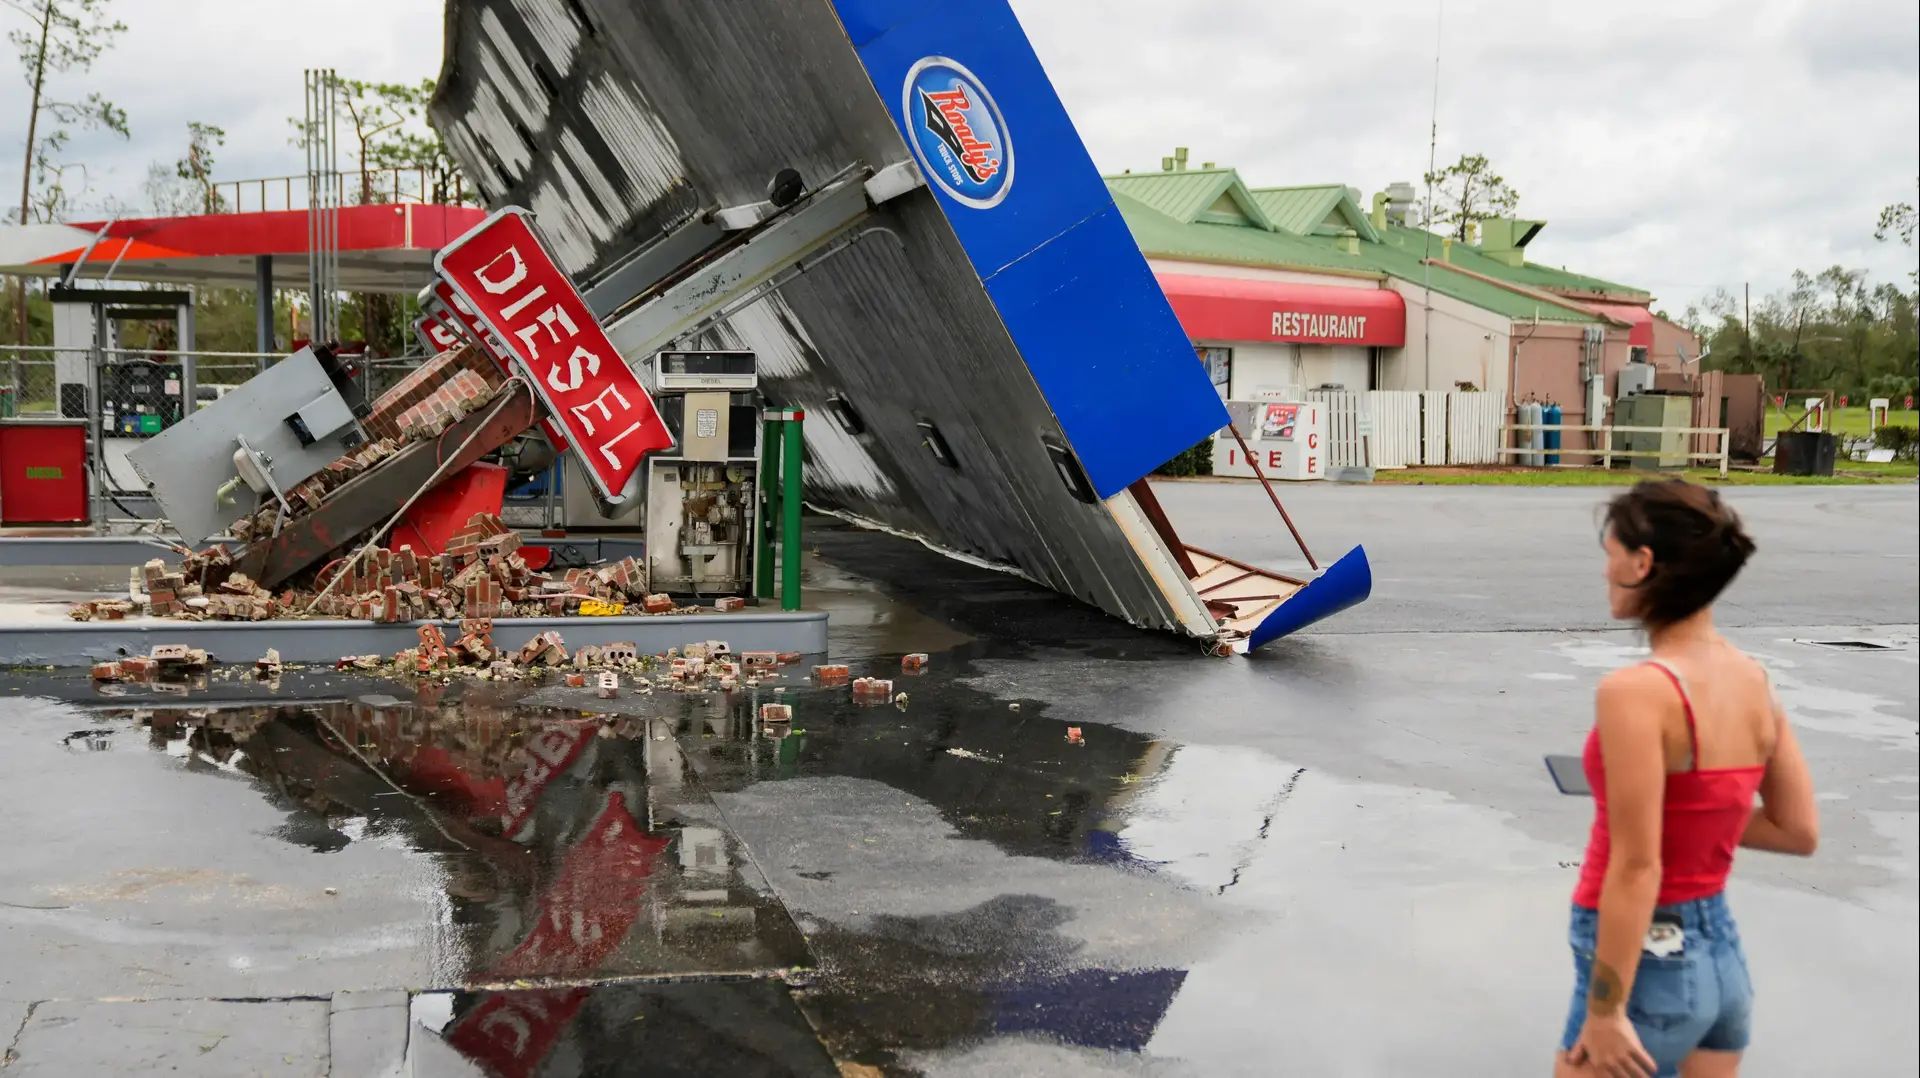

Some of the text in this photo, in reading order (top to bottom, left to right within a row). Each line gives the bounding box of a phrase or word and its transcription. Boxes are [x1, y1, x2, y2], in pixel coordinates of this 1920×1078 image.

[926, 84, 1000, 181] Roady's
[937, 142, 964, 186] TRUCK STOPS
[1271, 311, 1367, 339] RESTAURANT
[473, 245, 642, 471] DIESEL
[1308, 409, 1318, 473] ICE
